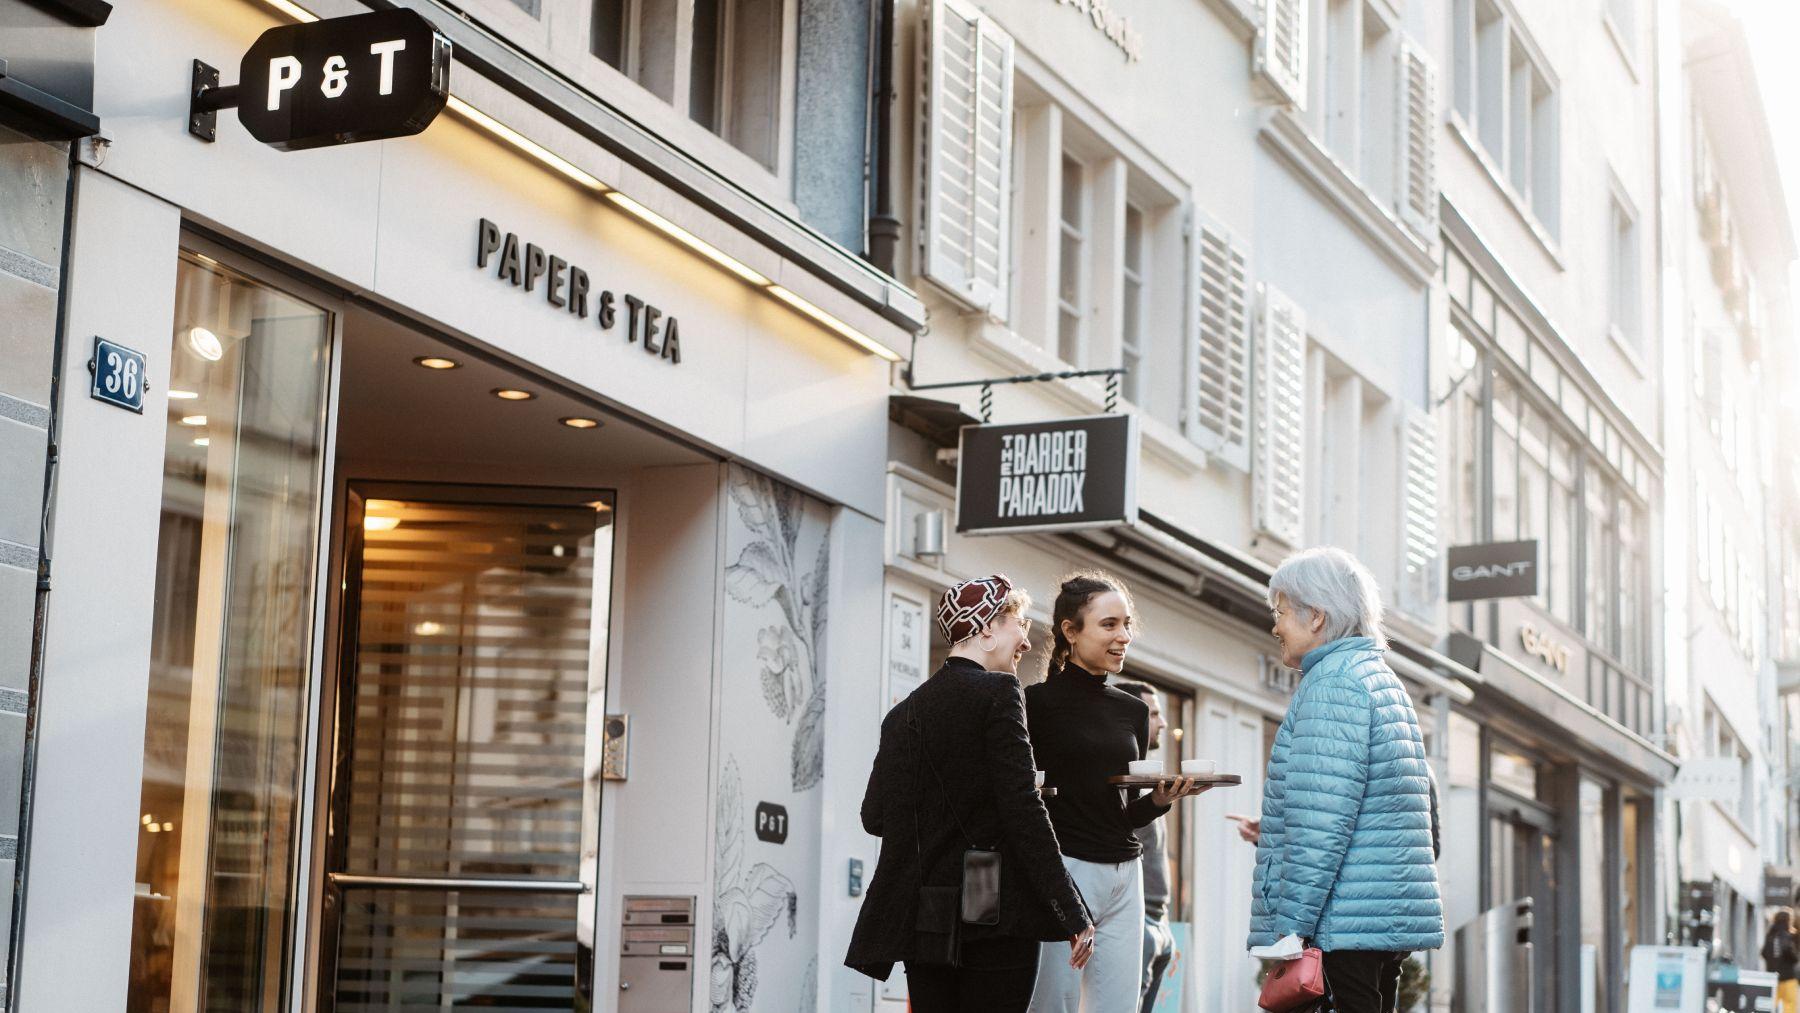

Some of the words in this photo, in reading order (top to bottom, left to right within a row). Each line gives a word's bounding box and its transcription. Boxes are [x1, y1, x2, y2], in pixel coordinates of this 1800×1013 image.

[477, 217, 590, 318] PAPER
[599, 290, 616, 330] &
[624, 293, 681, 364] TEA
[105, 351, 138, 399] 36
[1001, 434, 1014, 476] THE
[1013, 429, 1088, 475] BARBER
[998, 471, 1086, 518] PARADOX
[1452, 560, 1533, 581] GANT
[1520, 620, 1571, 674] GANT
